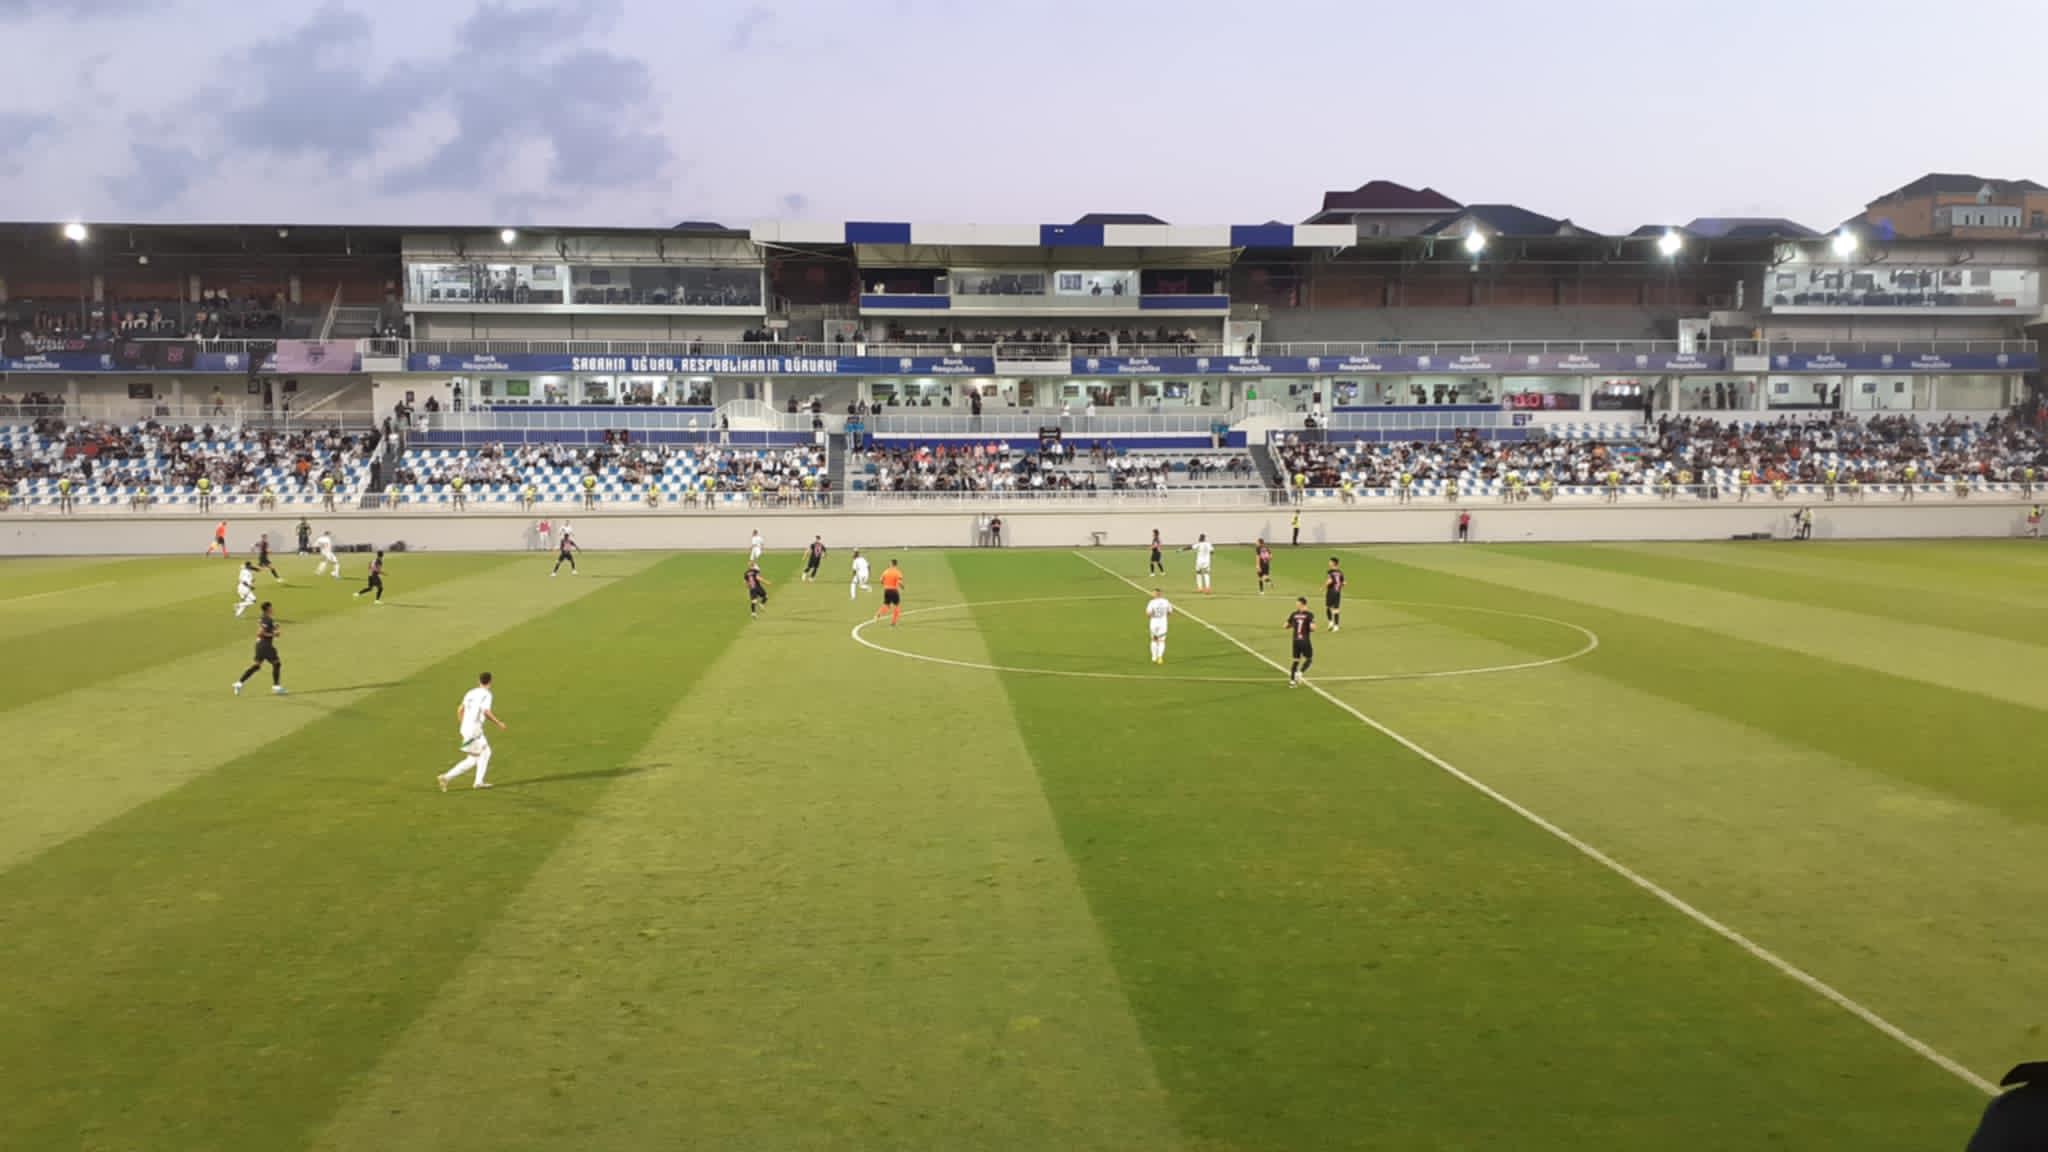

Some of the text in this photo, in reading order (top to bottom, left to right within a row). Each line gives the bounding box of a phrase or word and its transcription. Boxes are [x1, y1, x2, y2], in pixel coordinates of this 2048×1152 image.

[572, 357, 625, 371] SABAHIN
[1129, 357, 1149, 365] Bank
[1239, 357, 1259, 365] Bank
[1118, 364, 1160, 373] Respublika
[1228, 364, 1271, 373] Respublika
